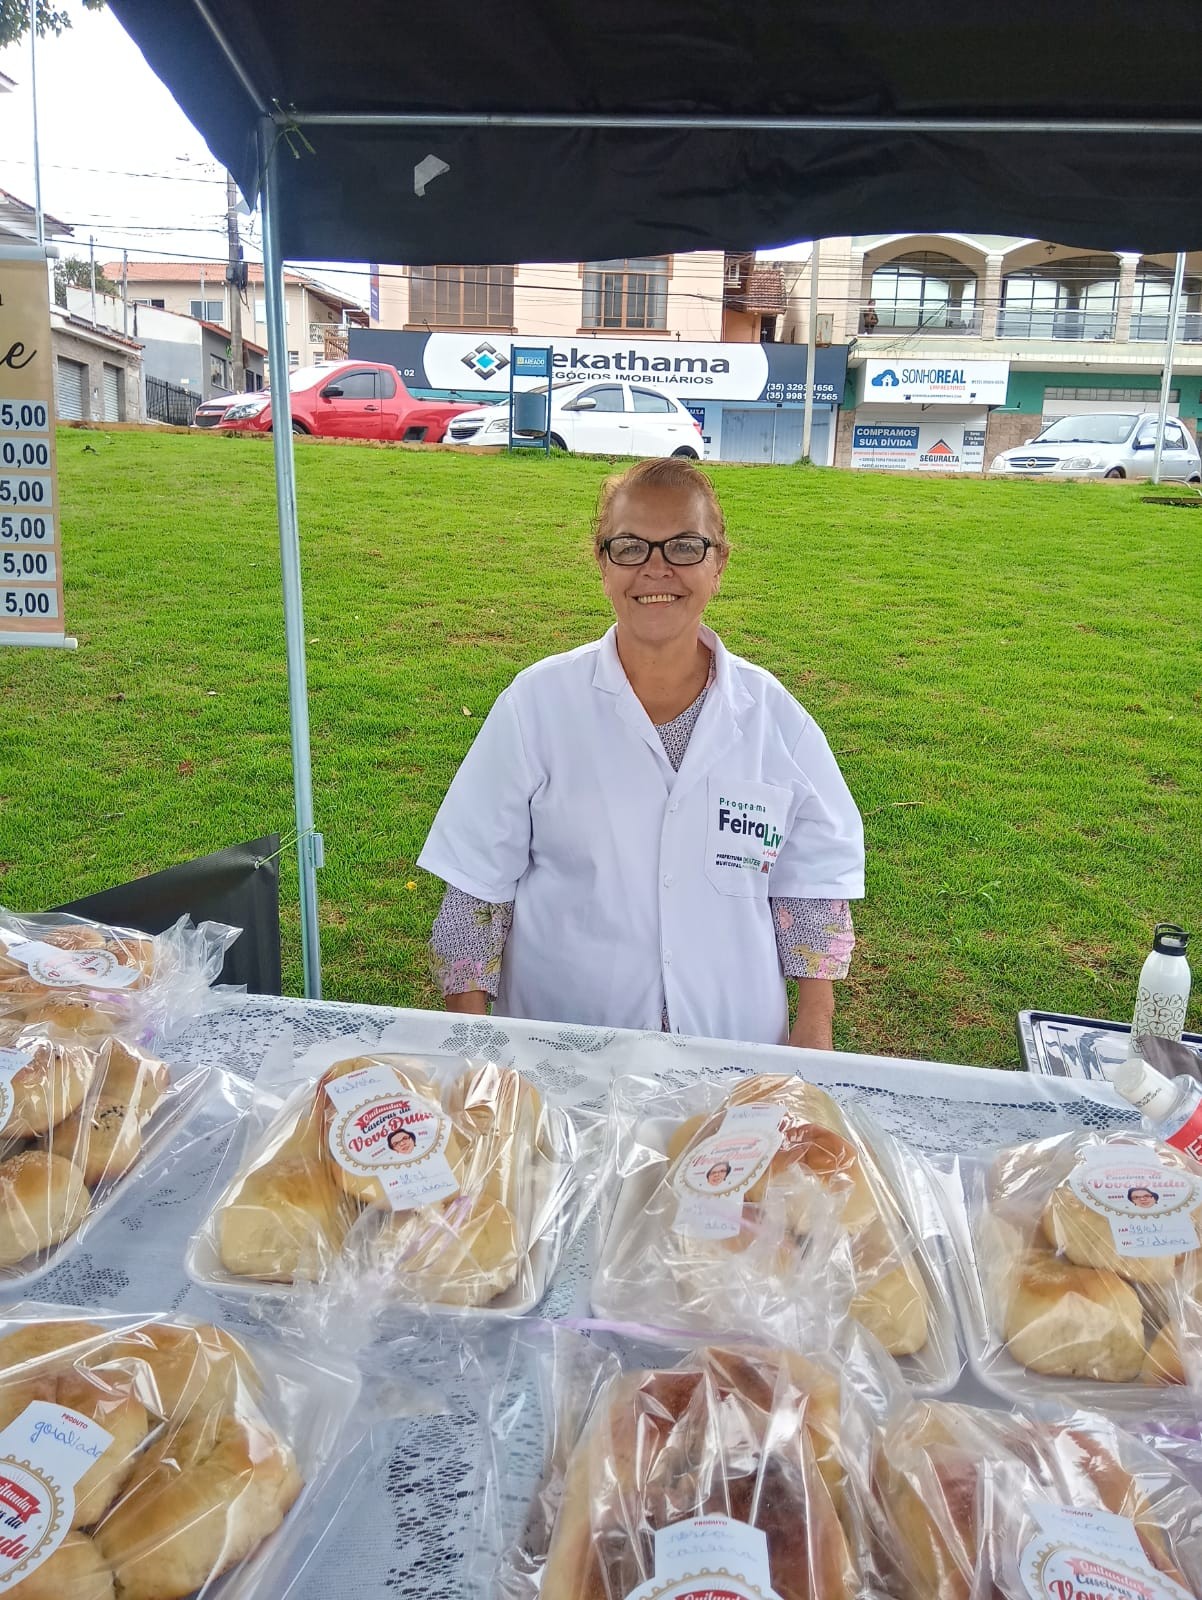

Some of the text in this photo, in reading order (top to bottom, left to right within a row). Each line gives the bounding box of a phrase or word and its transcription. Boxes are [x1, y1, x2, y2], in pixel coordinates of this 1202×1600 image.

[552, 348, 730, 373] ekathama
[548, 371, 714, 384] GÓCIOS IMOBILIÁRIOS
[766, 383, 785, 391] (35)
[766, 392, 838, 400] (35) 9981-7565
[856, 428, 917, 437] COMPRAMOS
[859, 438, 913, 447] SUA DÍVIDA
[919, 454, 960, 463] SEGURALTA
[61, 1413, 89, 1430] PRODUTO
